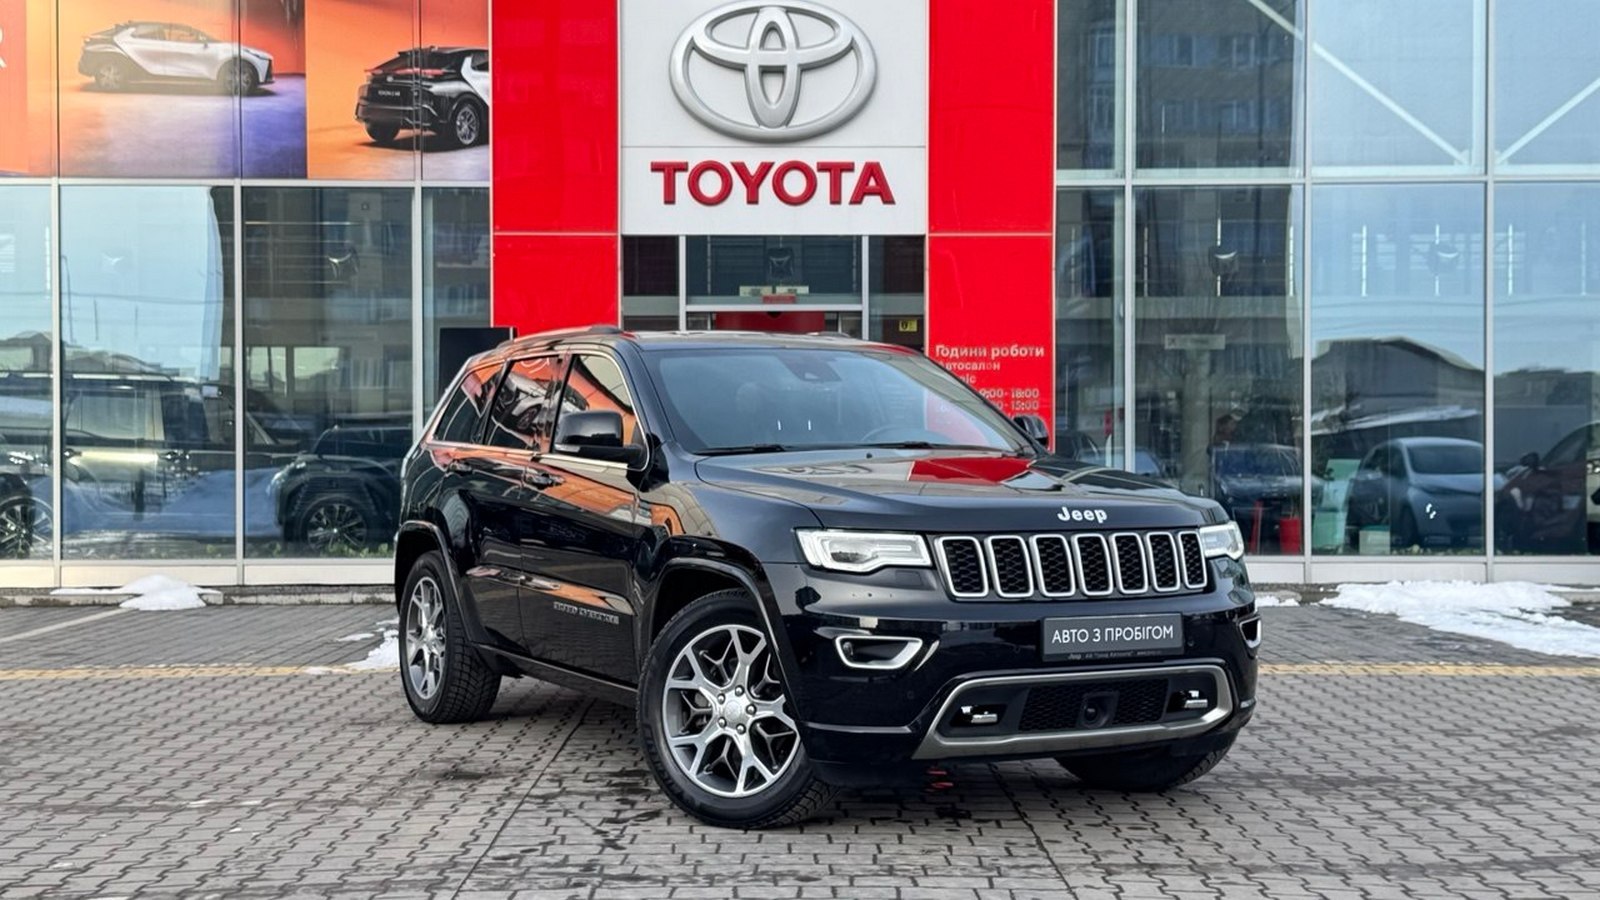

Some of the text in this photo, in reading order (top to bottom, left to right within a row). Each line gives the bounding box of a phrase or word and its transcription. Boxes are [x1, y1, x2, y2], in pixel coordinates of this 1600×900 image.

[650, 160, 896, 206] TOYOTA
[935, 344, 1045, 360] Години роботи
[1011, 388, 1040, 399] 18:00
[1057, 506, 1107, 524] Jeep
[1051, 625, 1174, 644] АВТО З ПРОБІГОМ
